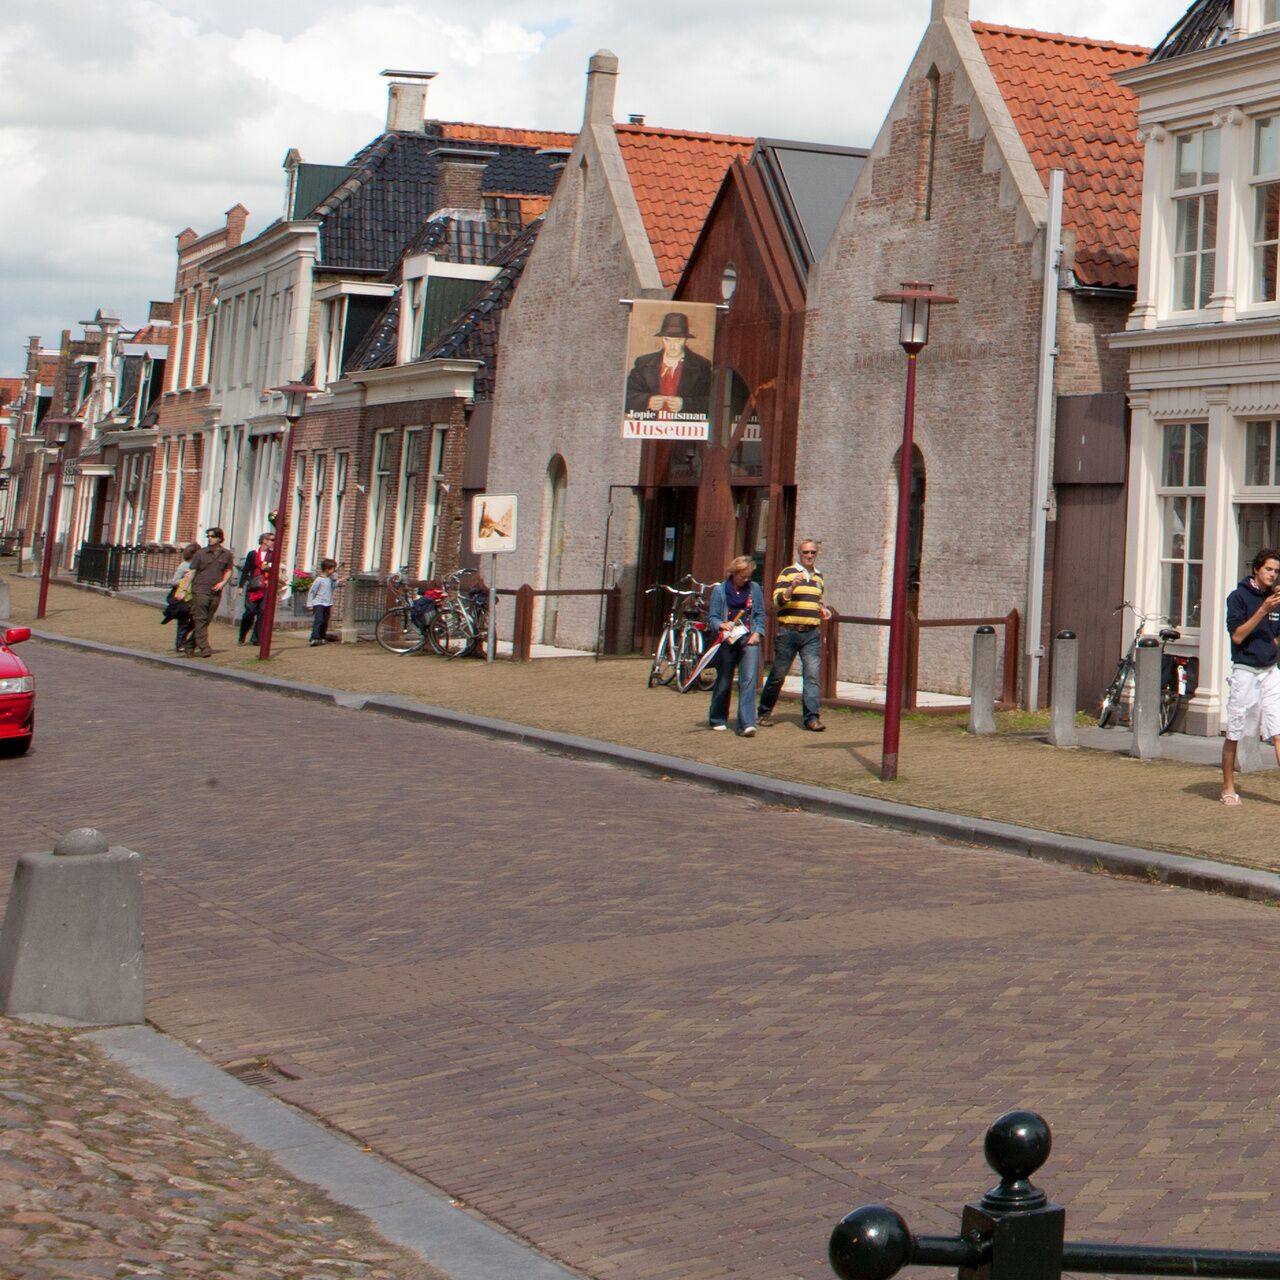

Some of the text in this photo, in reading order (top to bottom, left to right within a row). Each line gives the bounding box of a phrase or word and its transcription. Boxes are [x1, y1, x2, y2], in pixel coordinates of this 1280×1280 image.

[627, 409, 707, 420] Jopie Huisman
[629, 421, 705, 437] Museum
